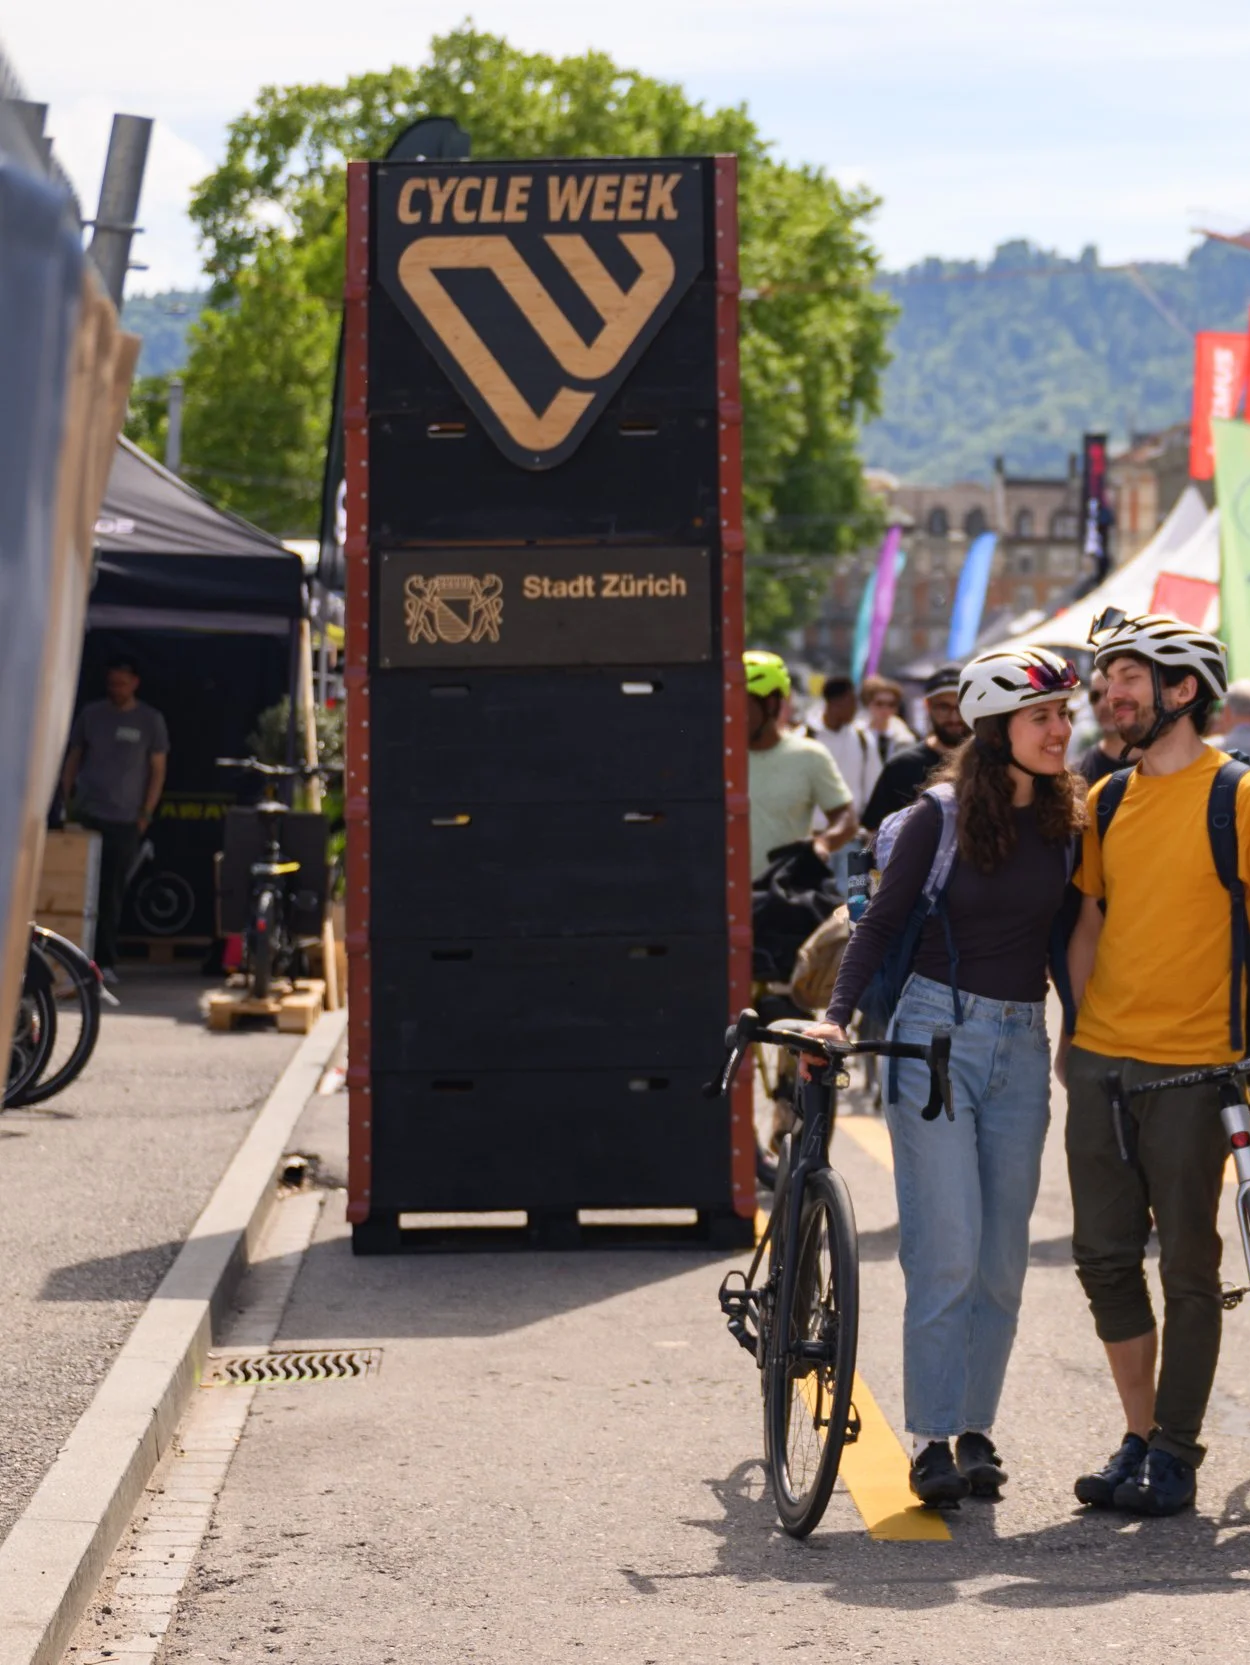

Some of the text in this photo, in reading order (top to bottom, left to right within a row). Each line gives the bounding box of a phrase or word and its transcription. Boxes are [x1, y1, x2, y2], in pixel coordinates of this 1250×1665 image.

[397, 173, 683, 224] CYCLE WEEK
[522, 573, 688, 599] Stadt Zürich
